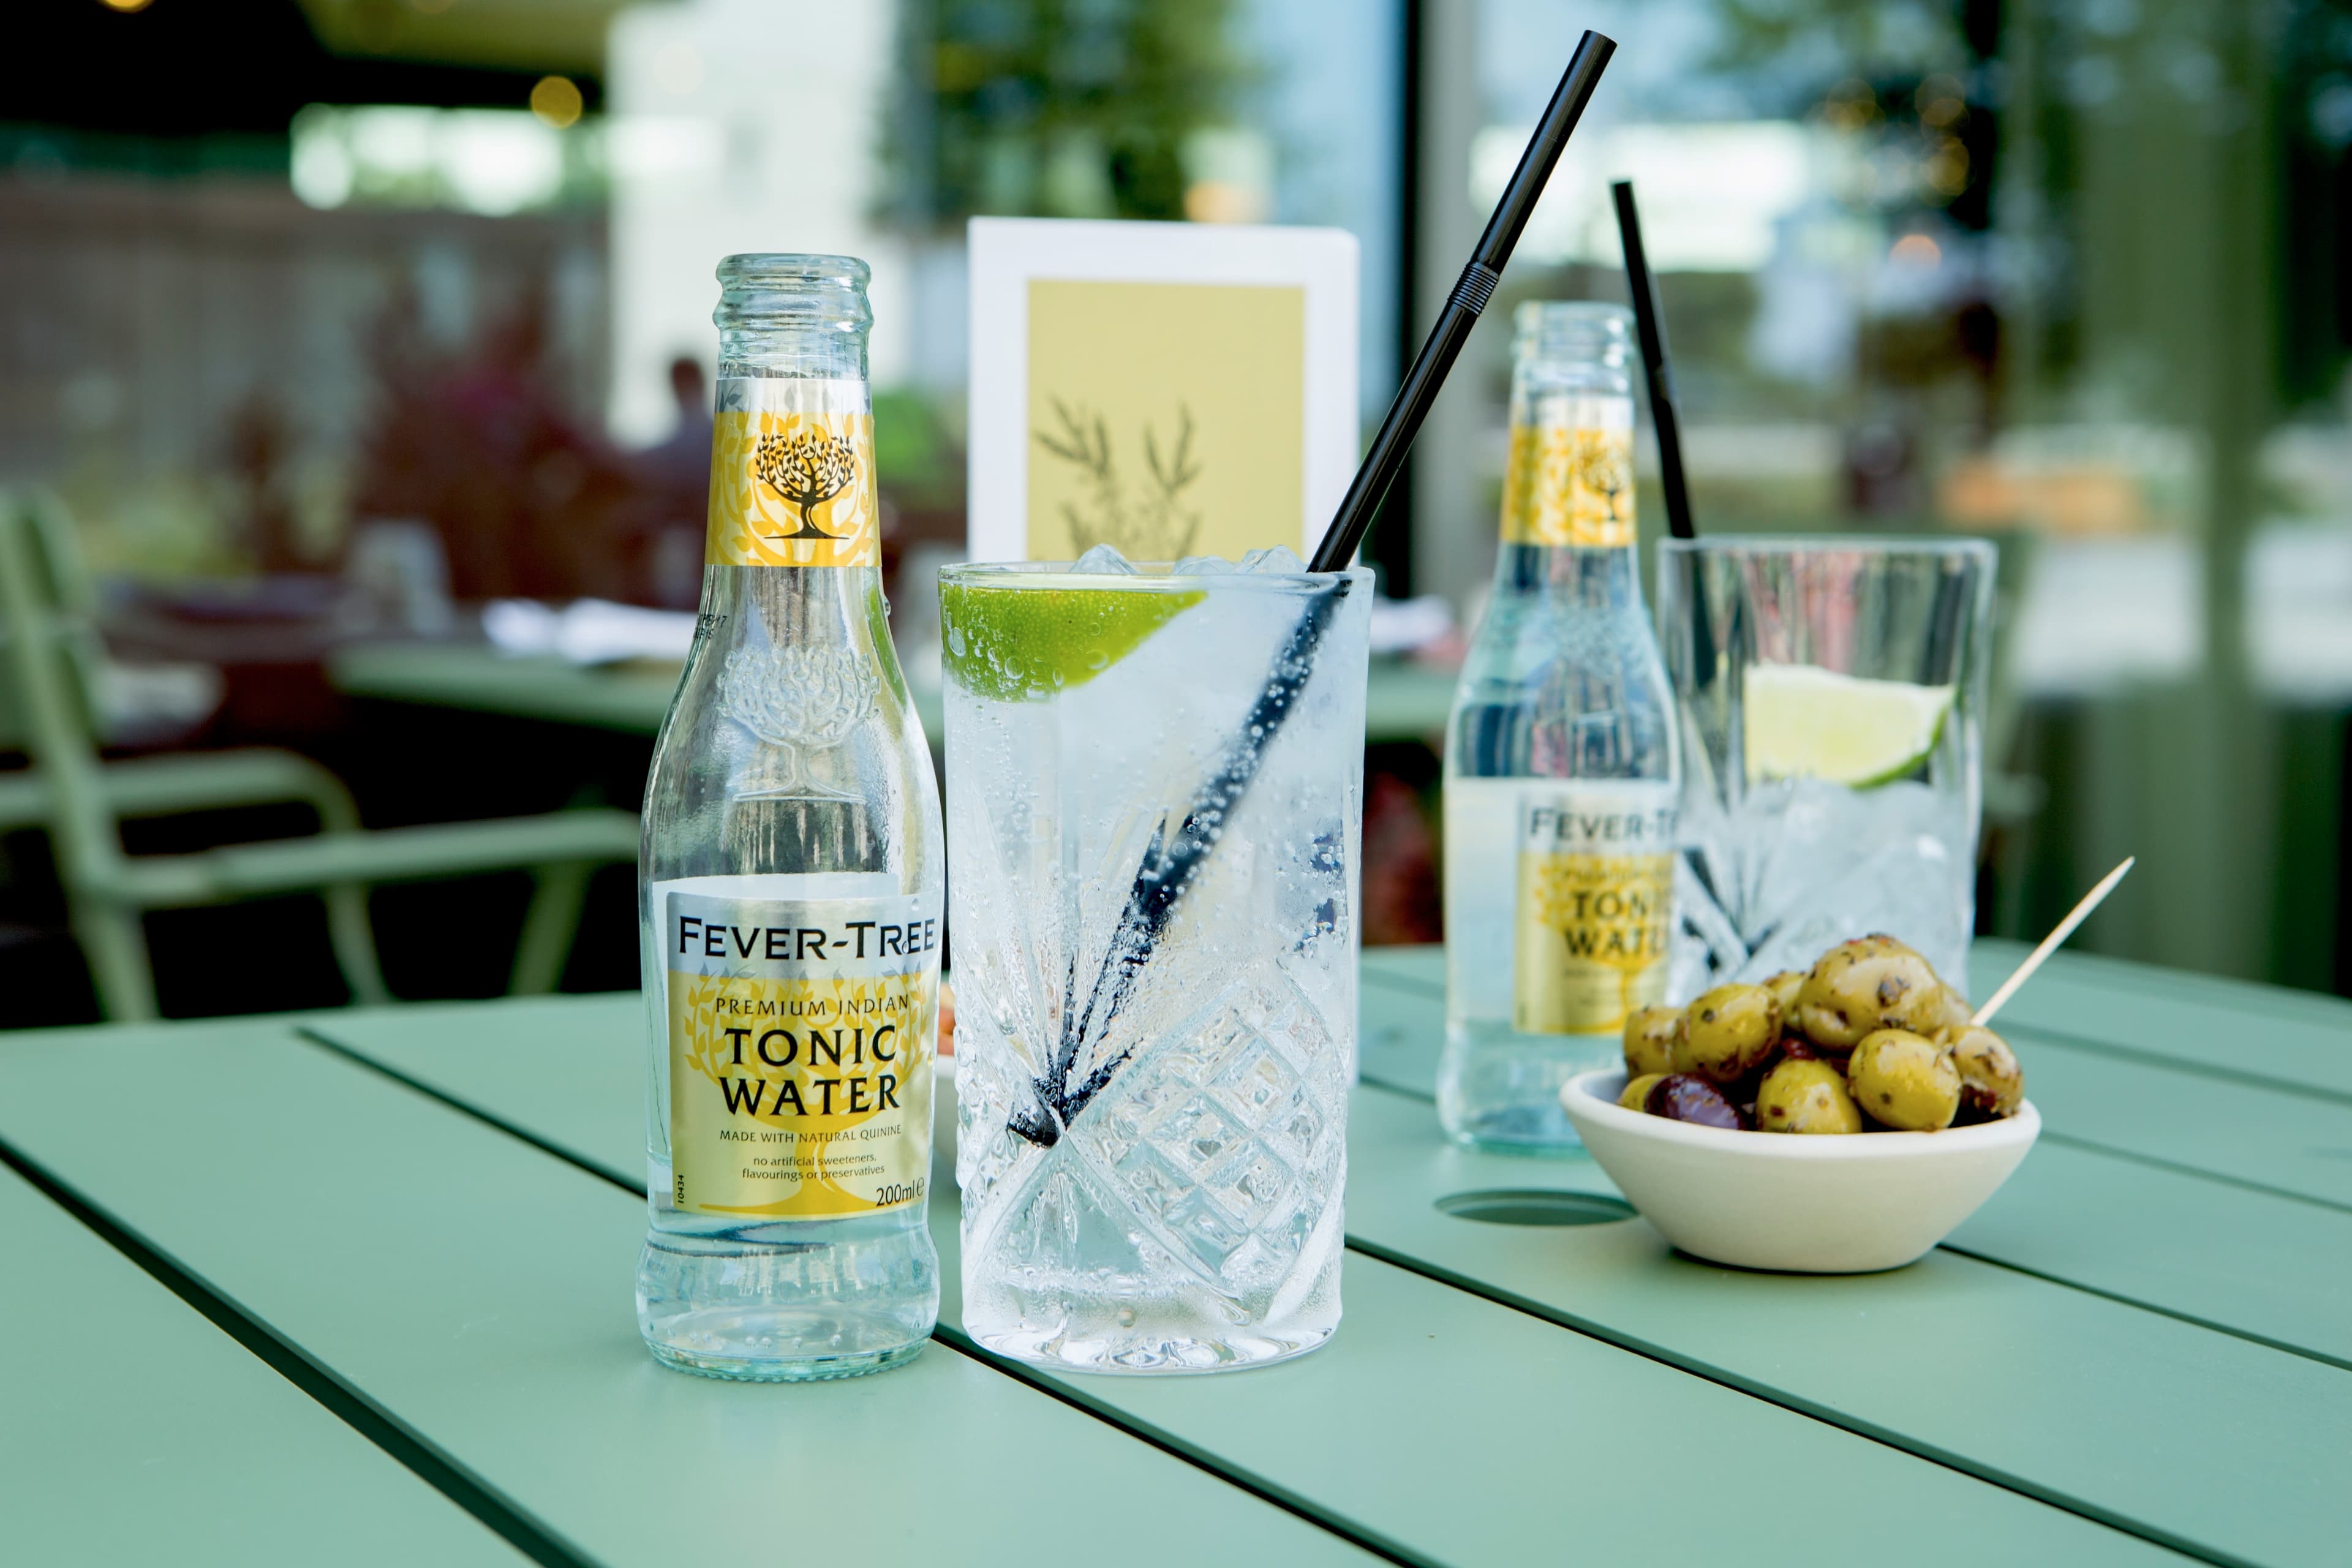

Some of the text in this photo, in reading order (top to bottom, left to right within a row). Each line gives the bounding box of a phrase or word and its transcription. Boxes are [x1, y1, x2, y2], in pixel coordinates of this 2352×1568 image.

[679, 916, 935, 960] FEVER-TREE
[716, 994, 909, 1017] PREMIUM INDIAN
[724, 1024, 897, 1067] TONIC
[718, 1074, 901, 1117] WATER
[720, 1125, 902, 1144] MADE WITH NATURAL QUININE
[753, 1157, 768, 1166] no
[771, 1156, 815, 1167] artificial
[742, 1168, 804, 1182] flavourings
[821, 1165, 885, 1182] preservatives
